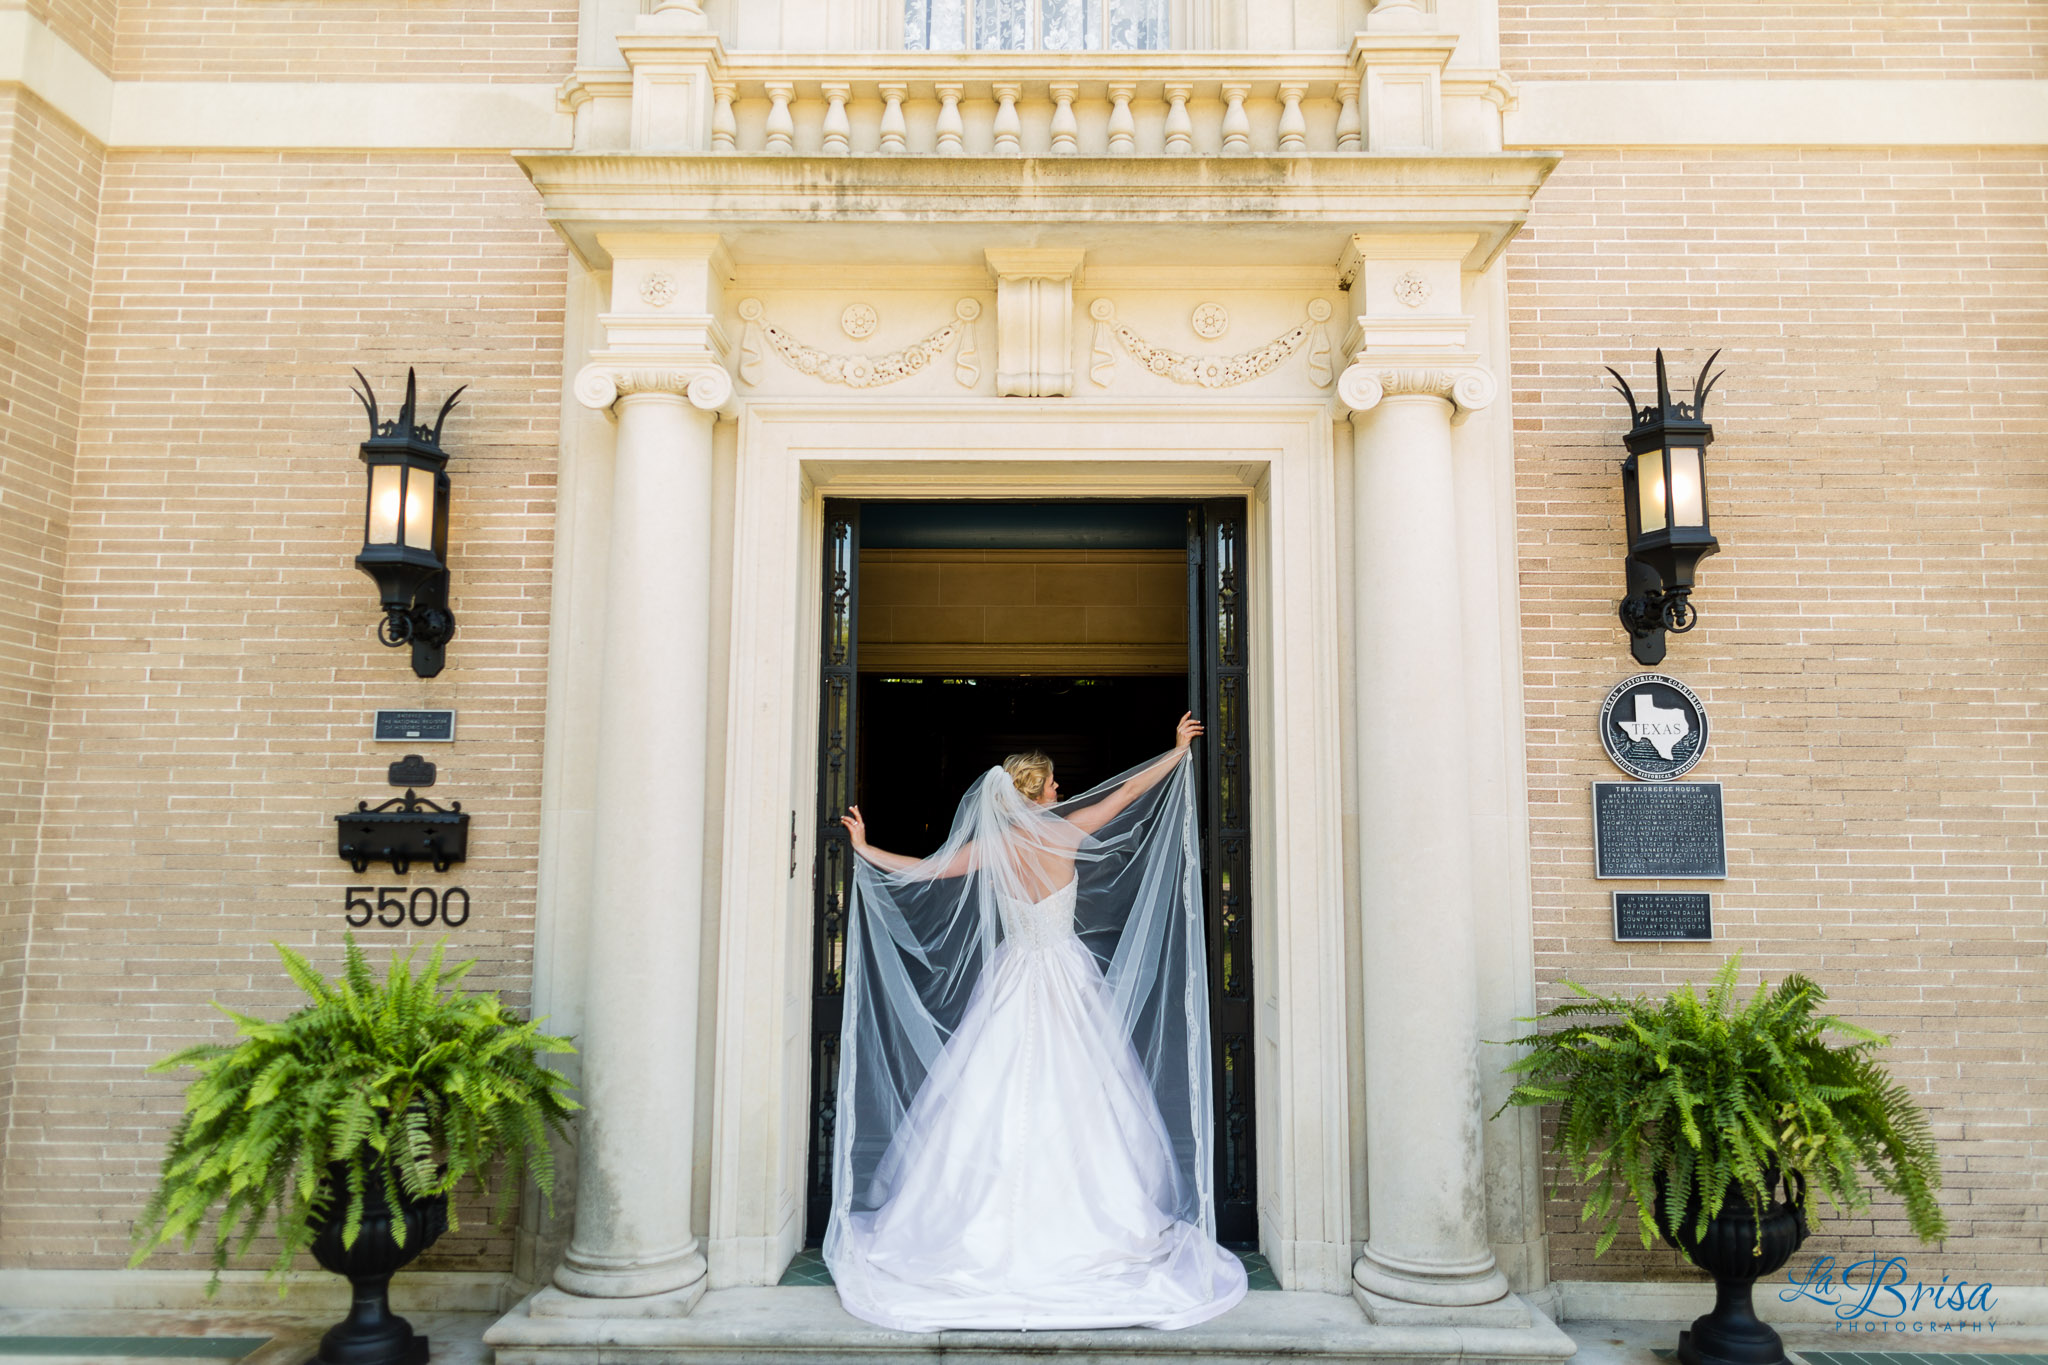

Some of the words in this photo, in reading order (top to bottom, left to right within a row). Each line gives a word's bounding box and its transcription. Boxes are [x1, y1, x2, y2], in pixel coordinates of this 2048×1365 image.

[1604, 692, 1618, 713] TEXAS
[1620, 676, 1664, 690] HISTORICAL
[1668, 679, 1704, 714] COMMISSION
[1632, 723, 1681, 735] TEXAS
[1612, 752, 1635, 773] OFFICIAL
[1638, 771, 1672, 779] HISTORICAL
[1675, 753, 1701, 775] MEDALLION
[344, 886, 470, 928] 5500
